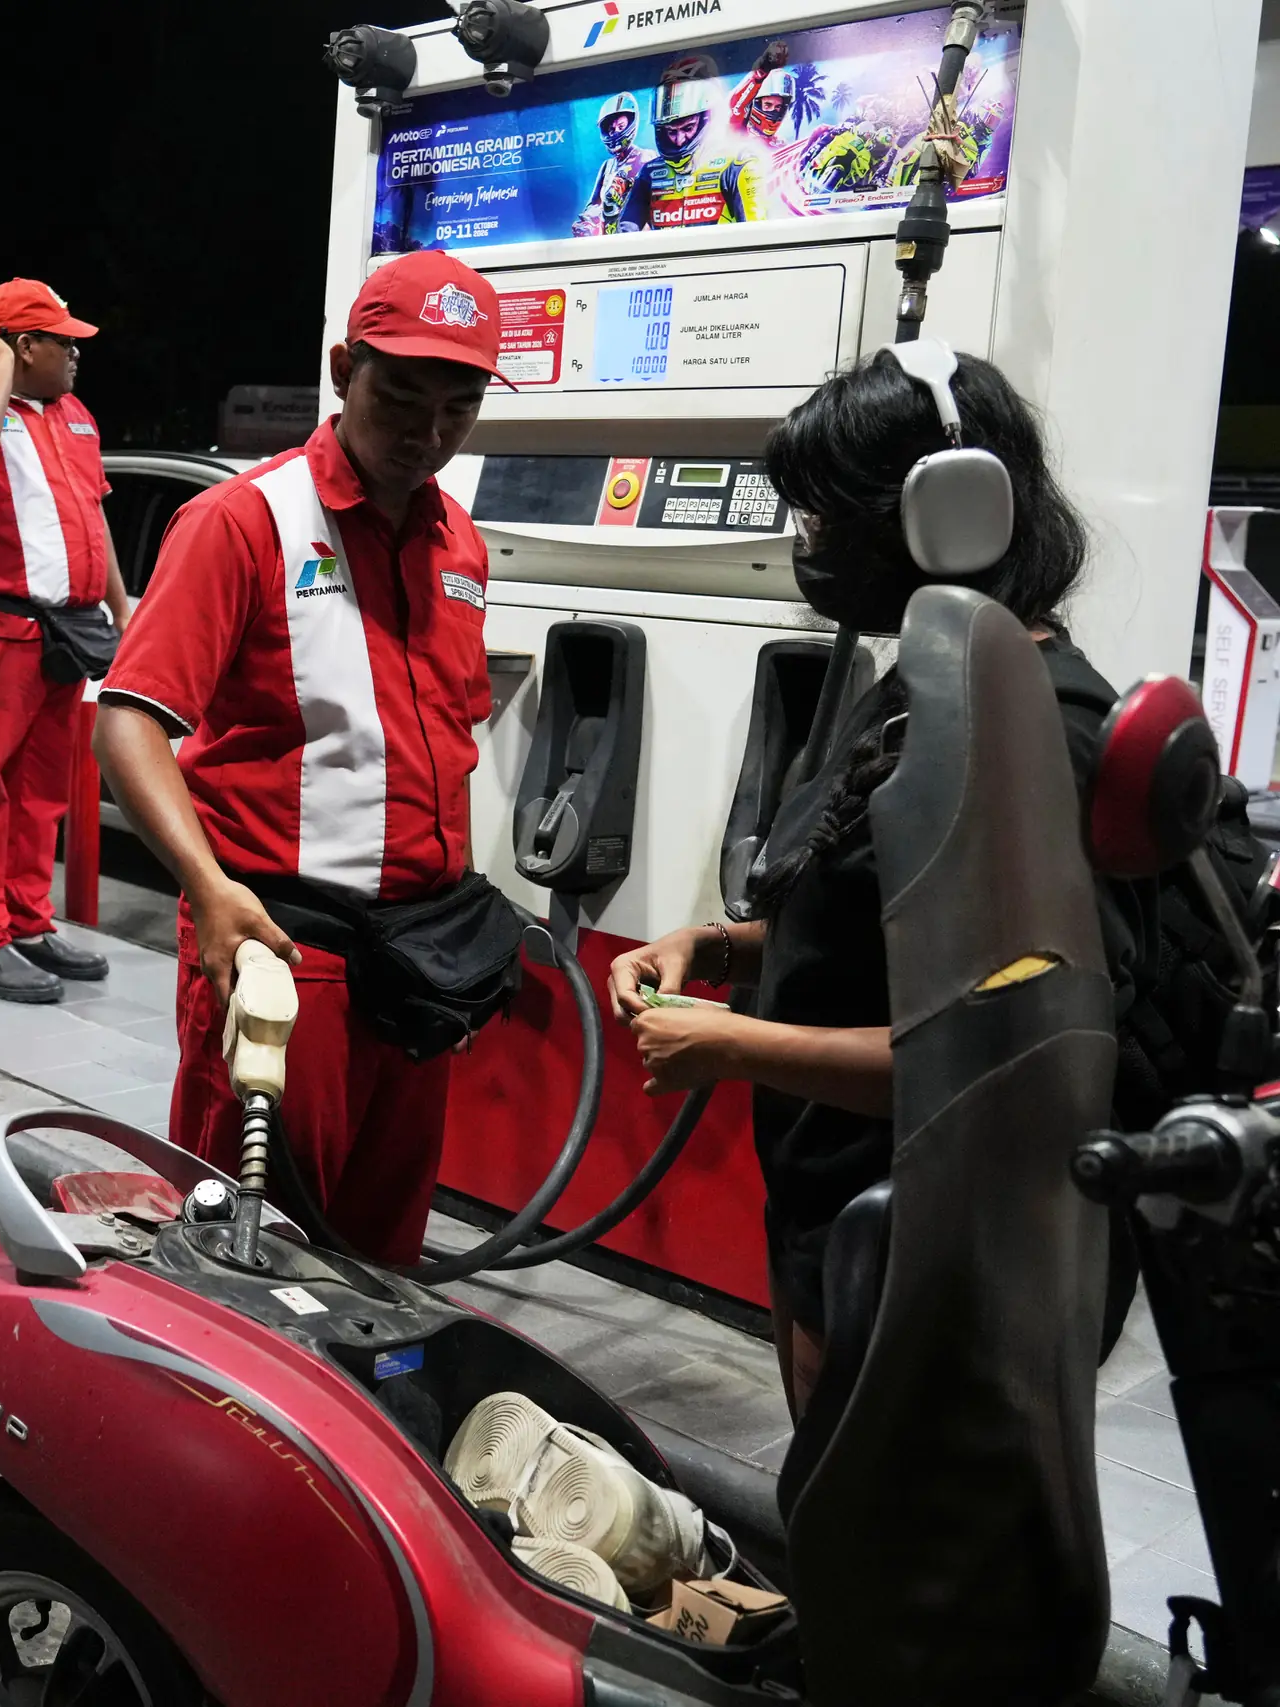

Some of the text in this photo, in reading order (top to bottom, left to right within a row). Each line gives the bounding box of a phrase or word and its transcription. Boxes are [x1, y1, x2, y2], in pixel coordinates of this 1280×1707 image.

[627, 0, 722, 30] PERTAMINA
[388, 128, 432, 144] MotoGP
[392, 129, 565, 165] PERTAMINA GRAND PRIX
[391, 150, 522, 179] OF INDONESIA 2026
[424, 185, 518, 213] Energizing Indonesia
[683, 196, 717, 206] PERTAMINA
[653, 207, 717, 223] Enduro
[473, 220, 498, 230] OCTOBER
[436, 224, 472, 241] 09-11
[473, 229, 488, 237] 2026
[693, 293, 749, 302] JUMLAH HARGA
[576, 299, 588, 312] Rp
[680, 323, 760, 333] JUMLAH DIKELUARKAN
[695, 331, 742, 340] DALAM LITER
[571, 359, 583, 372] Rp
[682, 356, 750, 366] HARGA SATU LITER
[739, 476, 745, 484] 7
[750, 476, 757, 485] 8
[735, 489, 741, 497] 4
[746, 489, 753, 498] 5
[759, 489, 766, 498] 6
[678, 500, 687, 508] P2
[744, 502, 750, 510] 2
[756, 502, 762, 511] 3
[730, 514, 736, 523] 0
[740, 514, 749, 524] C
[295, 584, 348, 599] PERTAMINA
[1215, 625, 1232, 667] SELF
